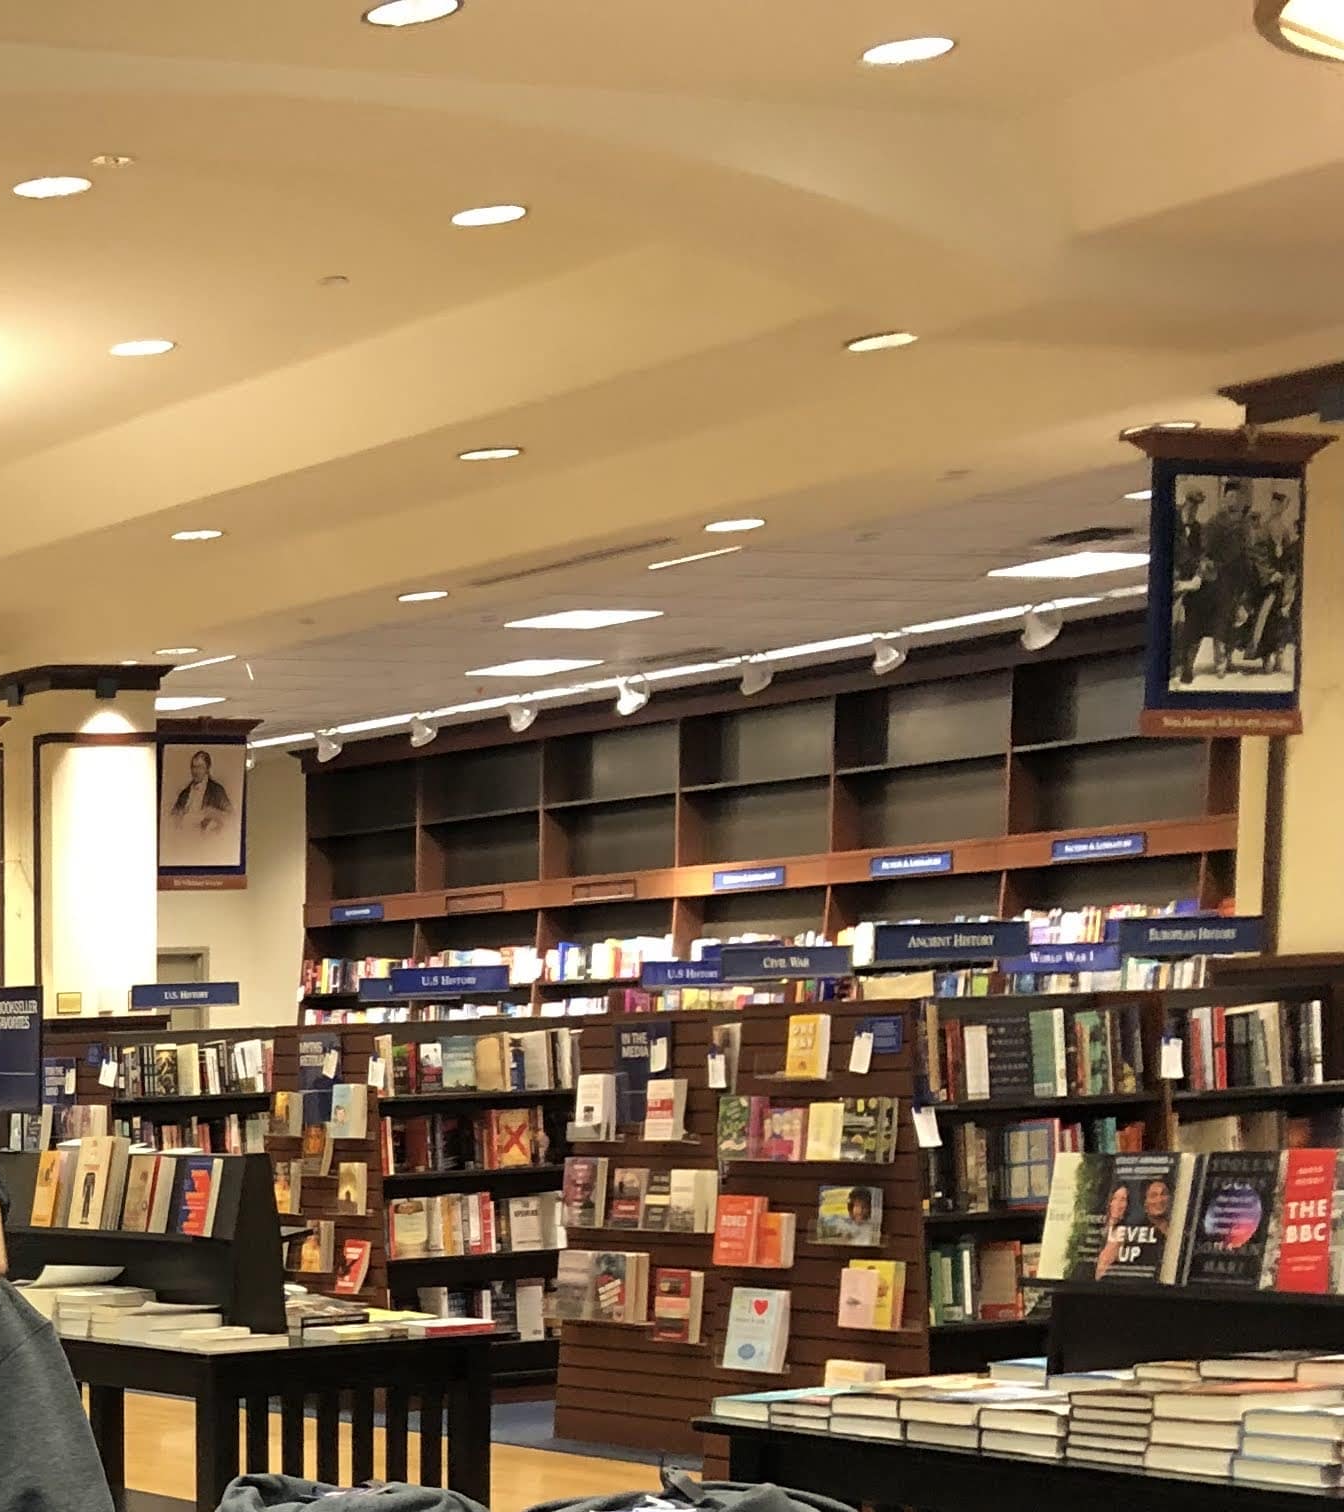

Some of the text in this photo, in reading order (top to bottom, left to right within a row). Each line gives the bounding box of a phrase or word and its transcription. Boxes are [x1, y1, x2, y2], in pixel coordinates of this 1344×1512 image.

[908, 933, 995, 948] ANCIENT HISTORY
[763, 957, 810, 968] CIVIL WAR
[1287, 1199, 1328, 1219] THE
[1108, 1225, 1157, 1243] LEVEL
[1285, 1223, 1327, 1243] BBC
[1118, 1246, 1141, 1262] UP
